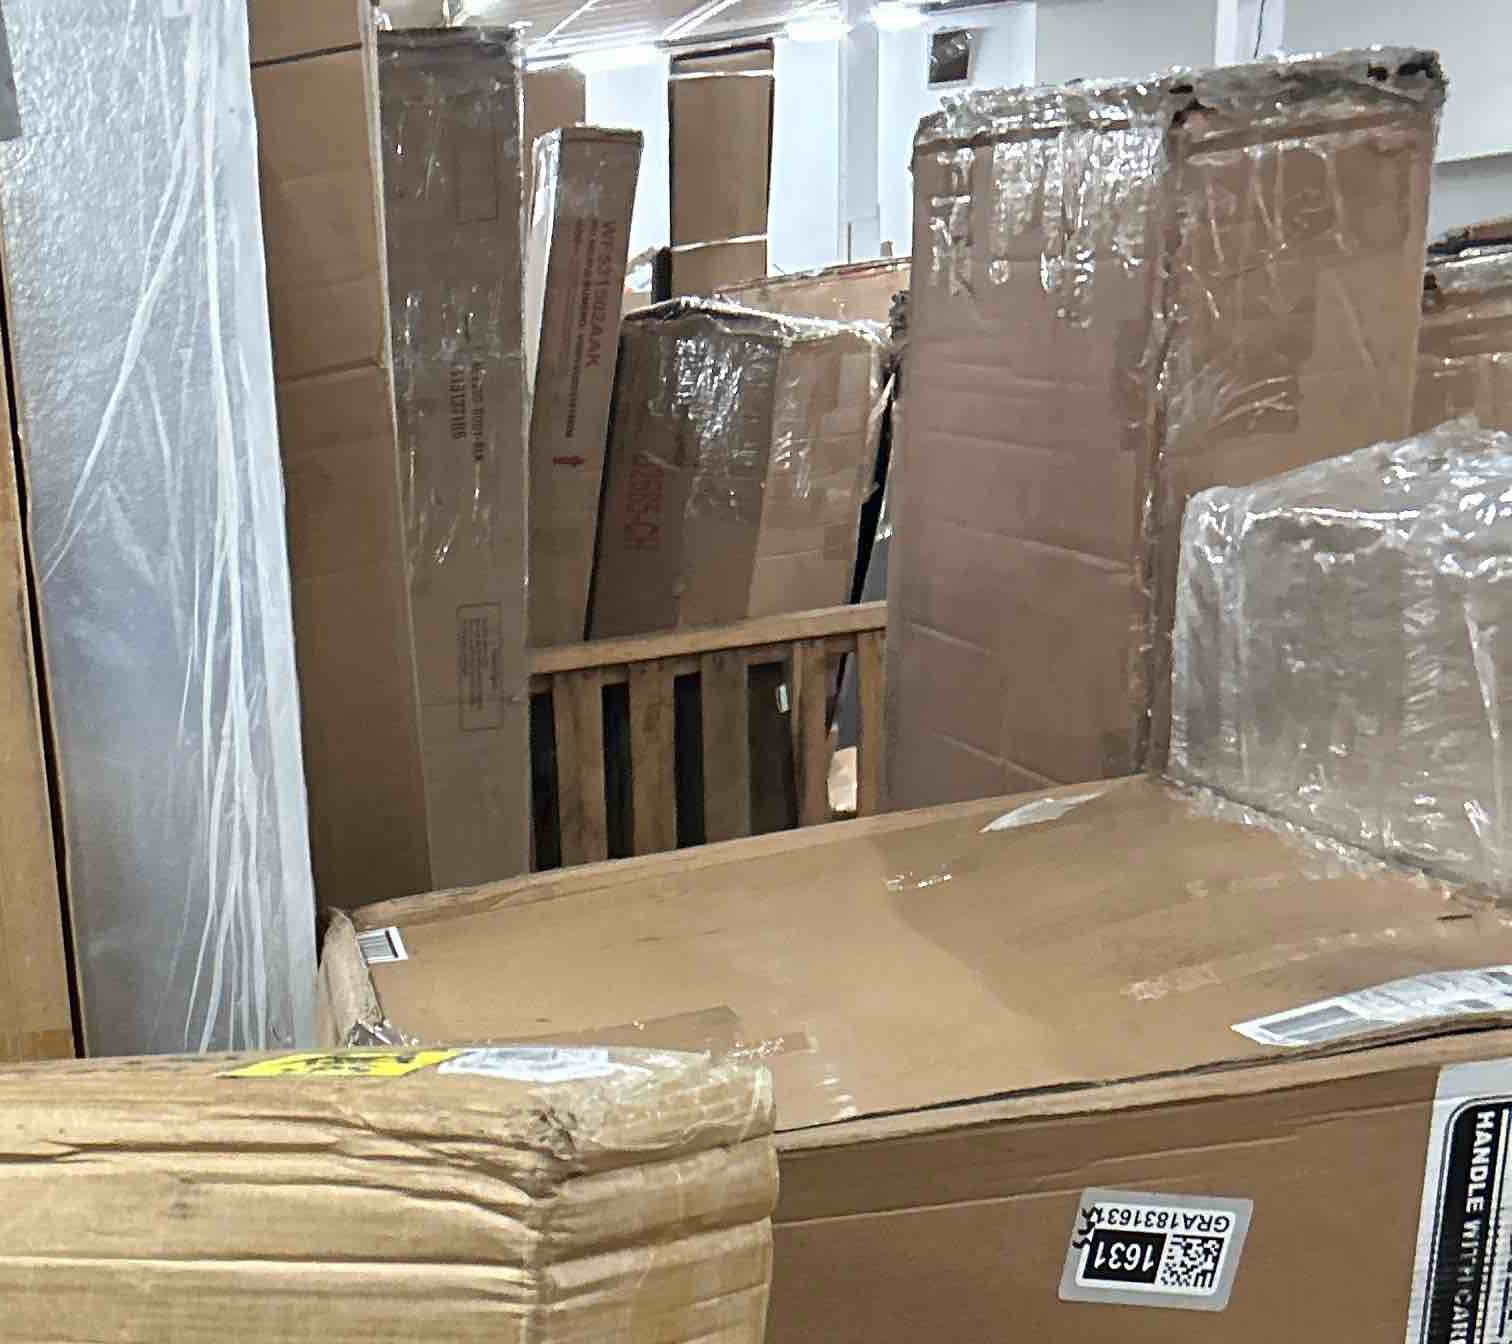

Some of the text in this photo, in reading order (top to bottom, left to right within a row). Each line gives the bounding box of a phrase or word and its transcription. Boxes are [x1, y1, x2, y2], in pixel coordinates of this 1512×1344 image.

[1465, 1109, 1496, 1214] HANDLE
[1094, 1206, 1231, 1234] GRA1831631
[1093, 1240, 1155, 1272] 1631
[1455, 1216, 1483, 1284] WITH
